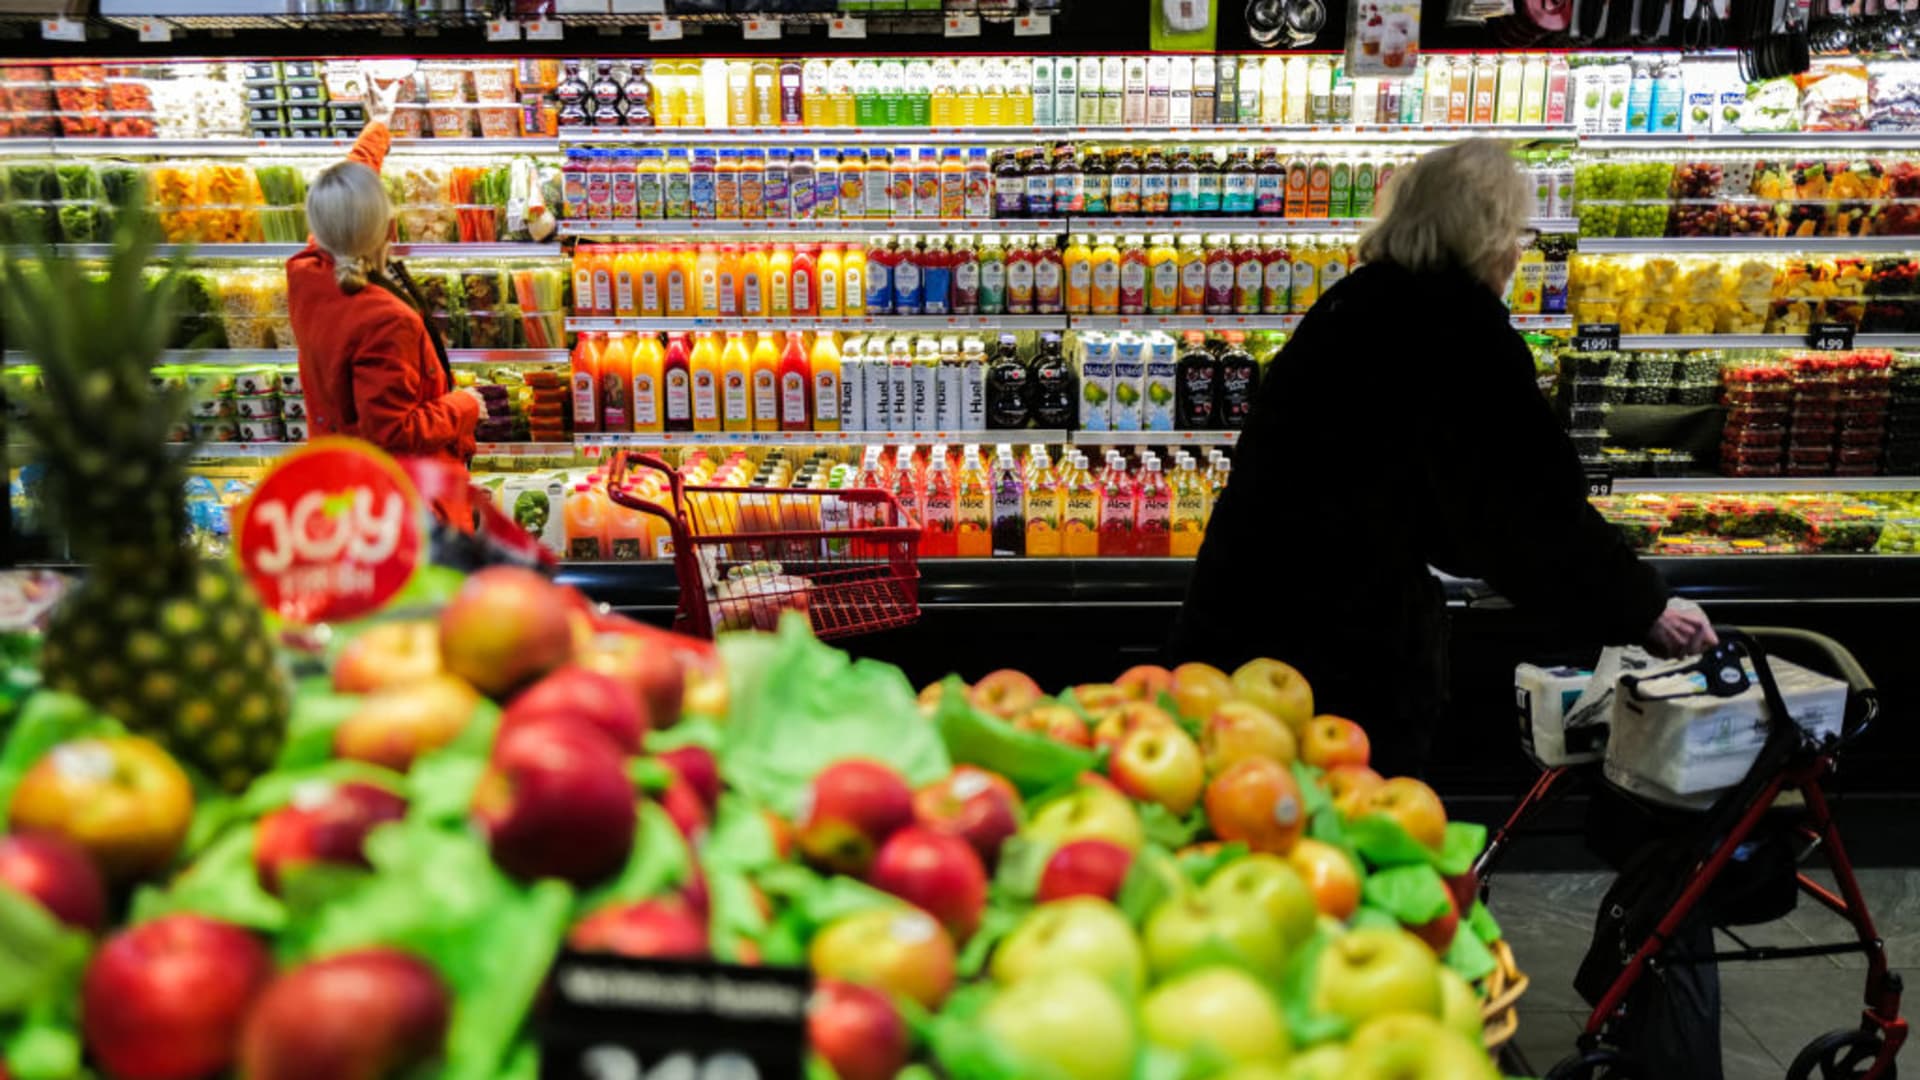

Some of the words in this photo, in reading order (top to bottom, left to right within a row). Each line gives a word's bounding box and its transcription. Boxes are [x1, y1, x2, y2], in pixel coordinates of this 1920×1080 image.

[970, 380, 982, 414] Huel
[1068, 500, 1092, 508] Aloe
[1108, 500, 1130, 509] Aloe
[1145, 500, 1168, 509] Aloe
[255, 485, 403, 575] JOY
